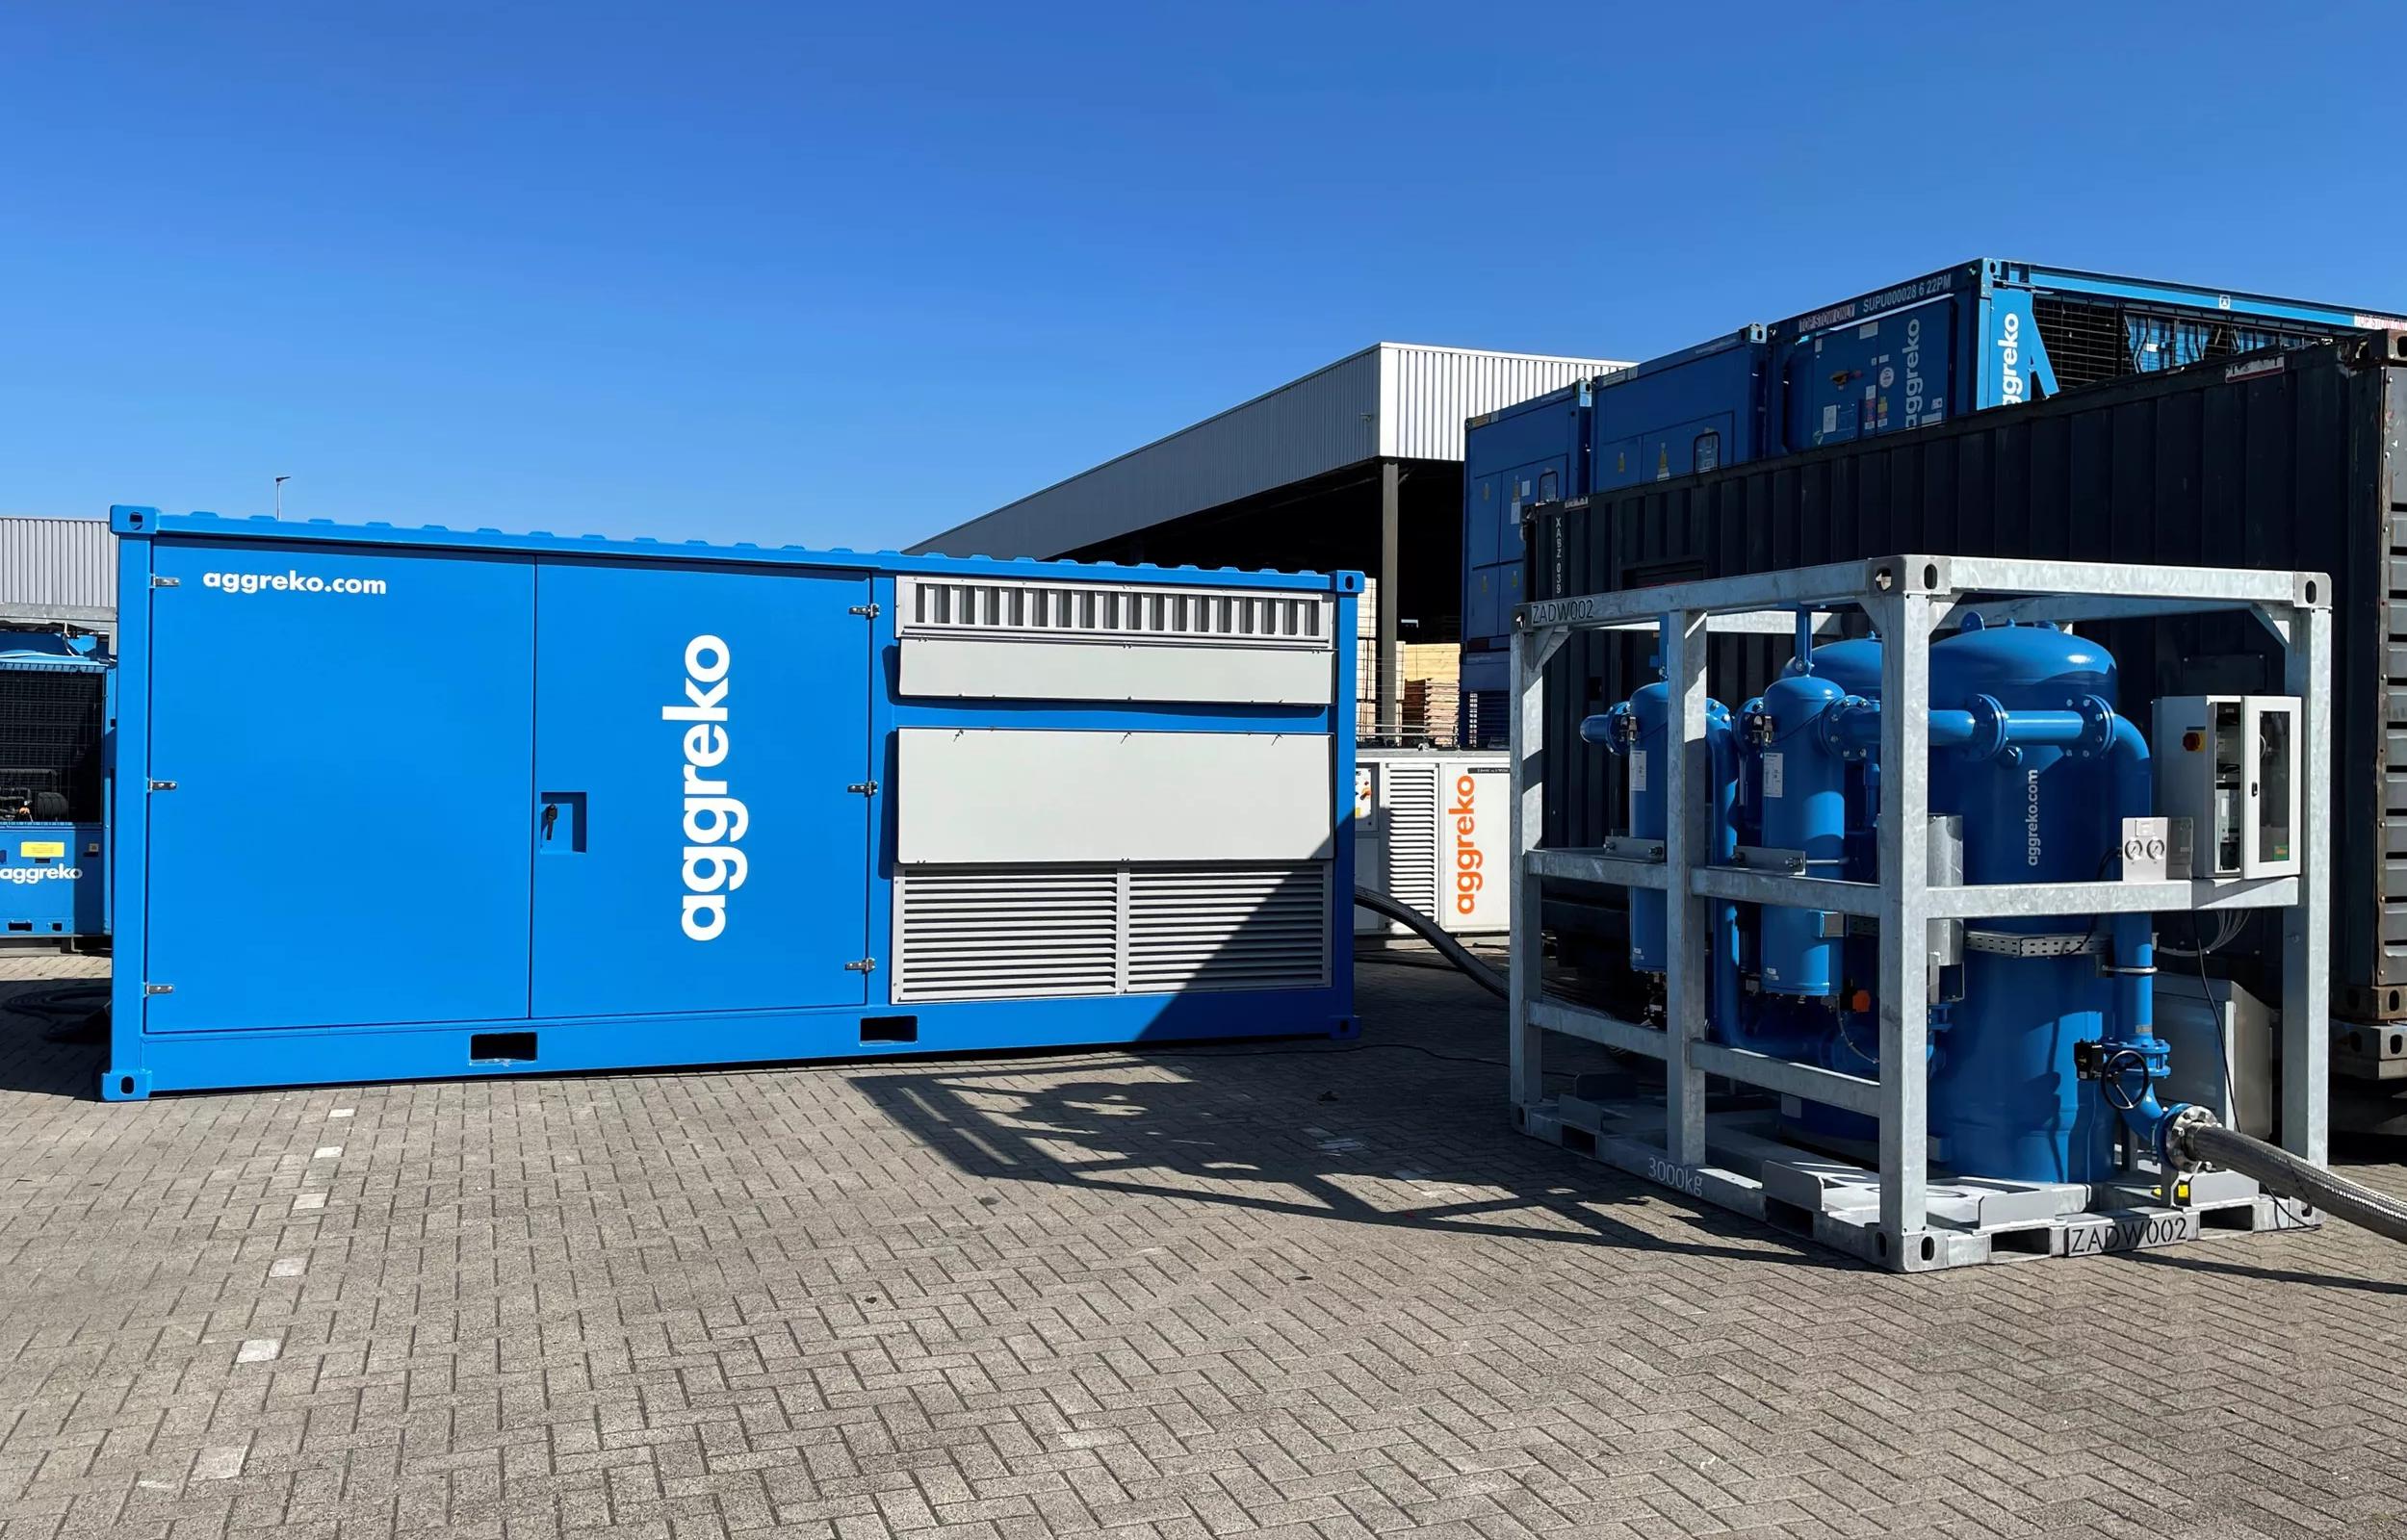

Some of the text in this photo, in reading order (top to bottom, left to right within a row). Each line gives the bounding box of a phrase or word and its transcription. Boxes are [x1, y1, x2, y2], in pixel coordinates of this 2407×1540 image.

[1997, 313, 2023, 405] greko
[202, 570, 387, 595] aggreko.com
[1532, 599, 1594, 624] ZADW002
[661, 634, 749, 941] aggreko
[2025, 769, 2041, 866] aggreko.com
[1448, 775, 1484, 914] aggreko
[0, 862, 83, 884] aggreko
[1648, 1157, 1703, 1197] 3000kg
[2070, 1217, 2187, 1252] ZADW002
